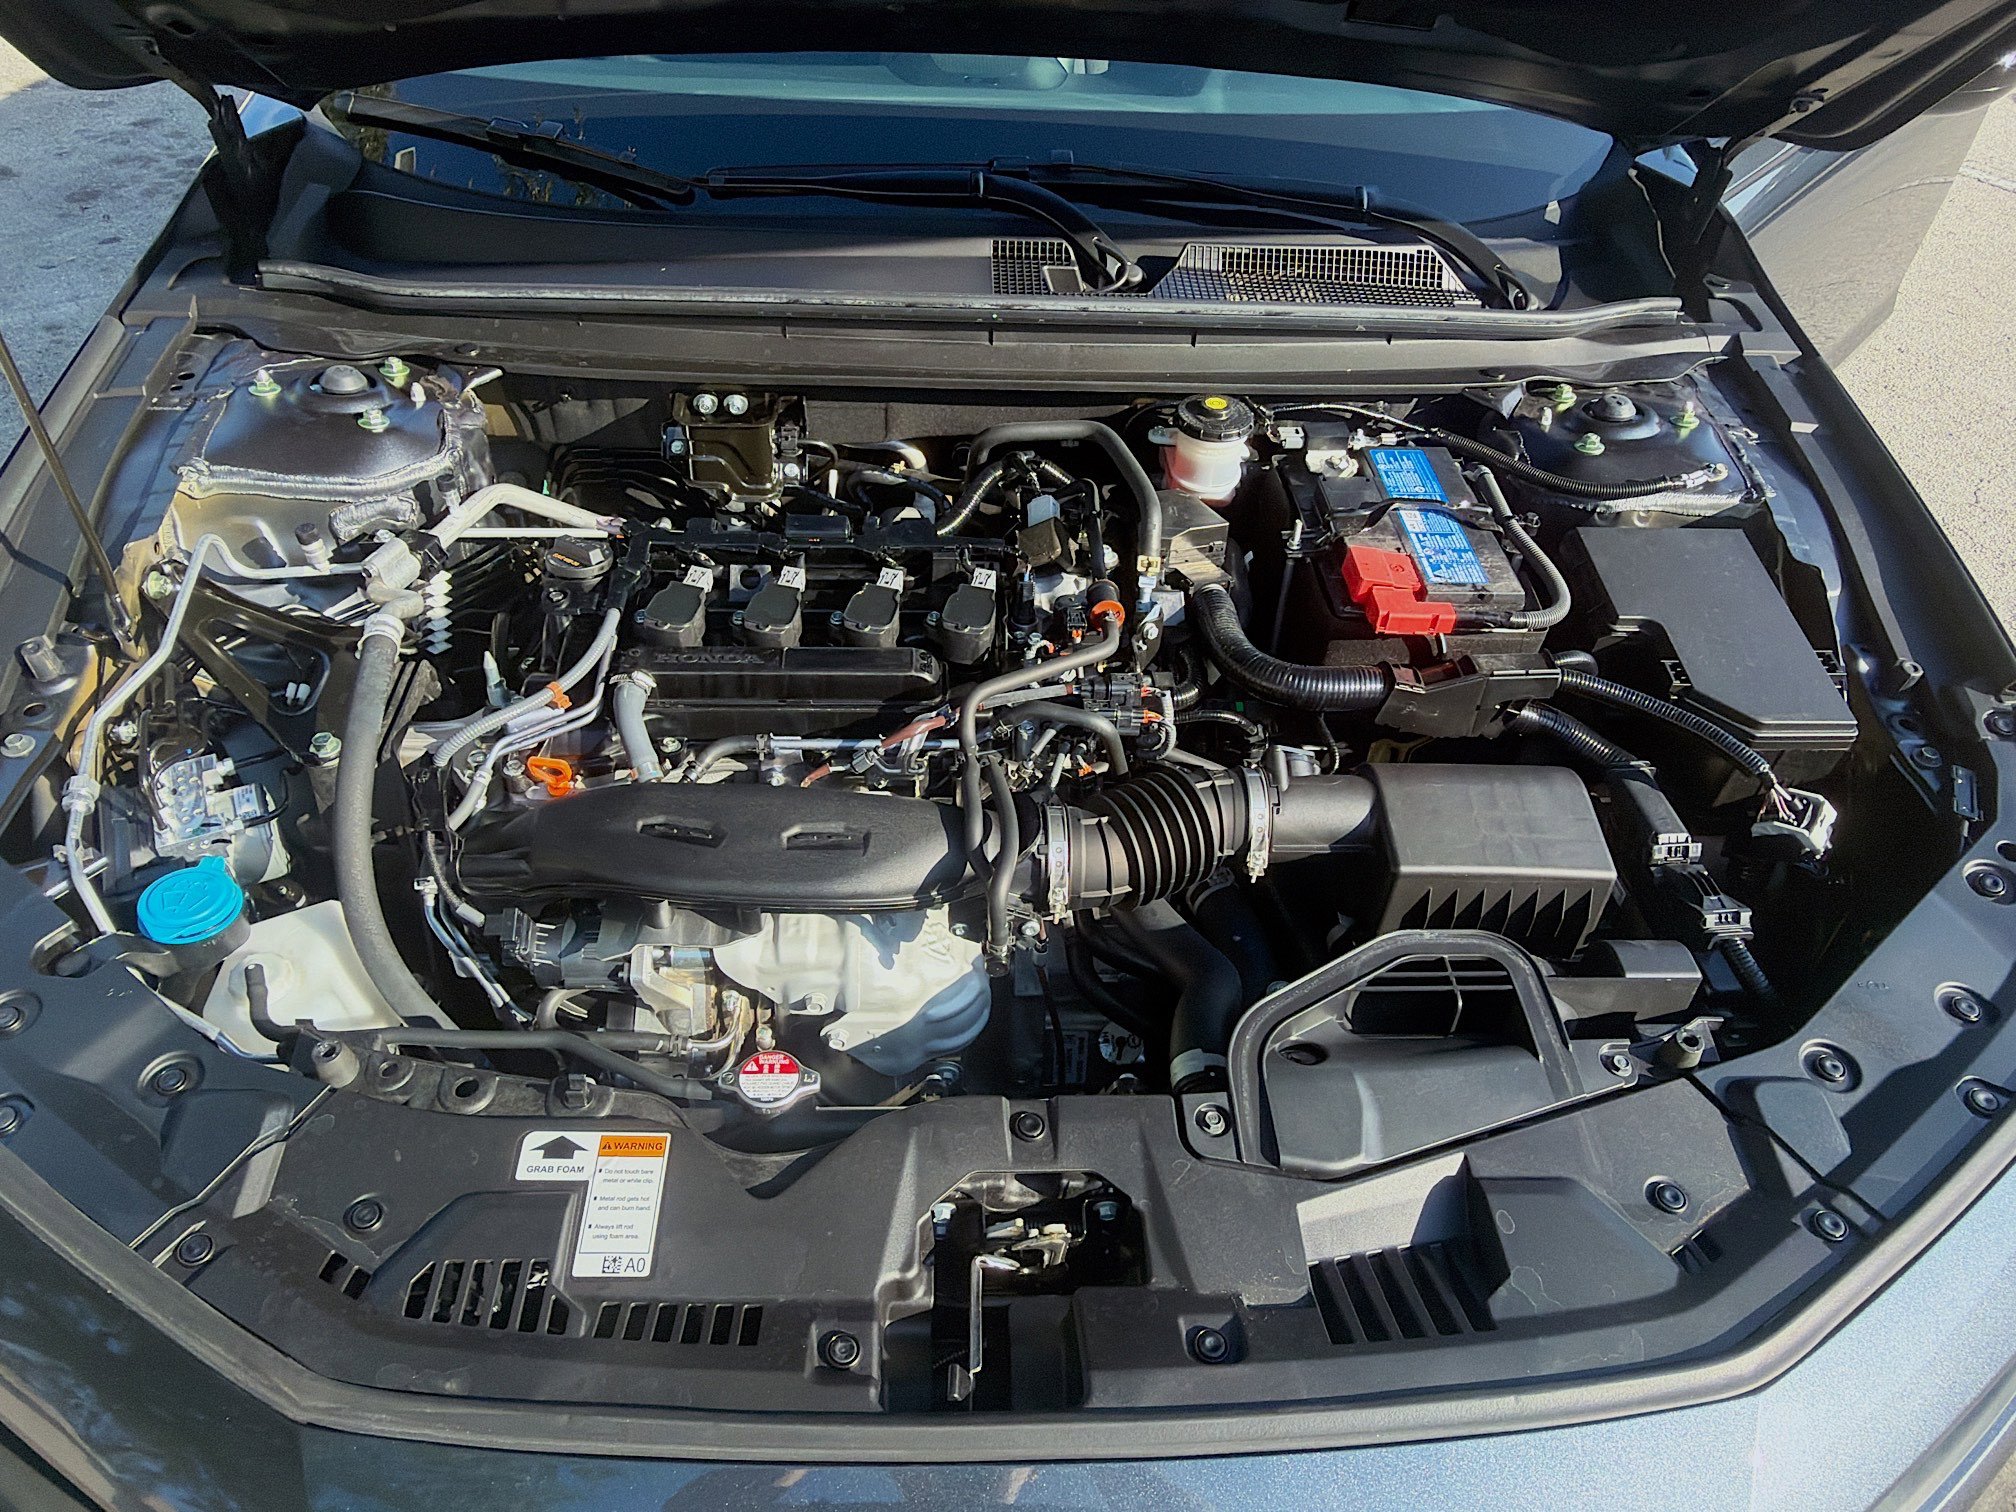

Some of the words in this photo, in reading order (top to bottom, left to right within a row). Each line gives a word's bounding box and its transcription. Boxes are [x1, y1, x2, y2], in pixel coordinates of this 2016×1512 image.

[653, 653, 765, 664] HONDA
[614, 1142, 663, 1151] WARNING
[526, 1165, 554, 1173] GRAB
[556, 1165, 585, 1173] FOAM
[624, 1258, 646, 1273] A0
